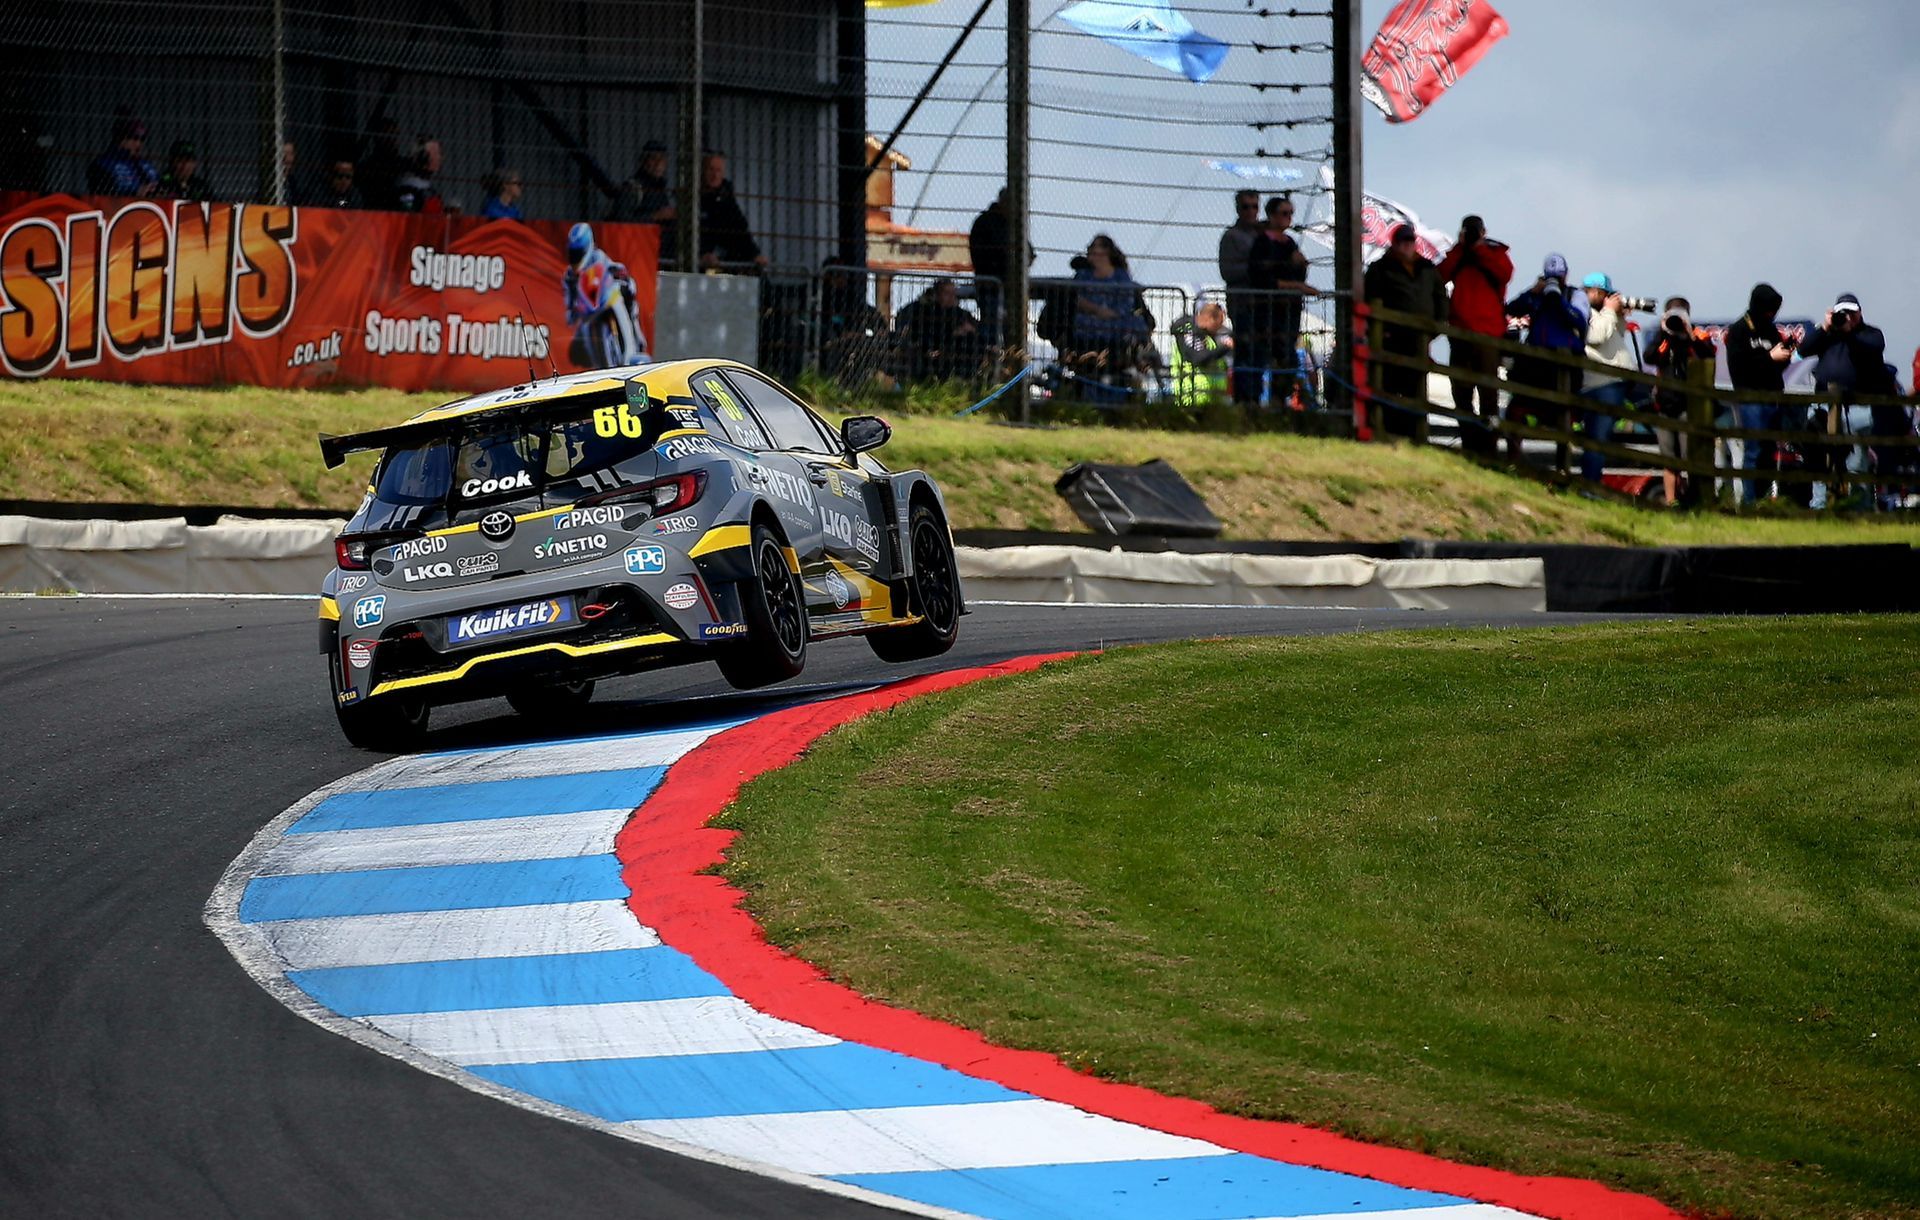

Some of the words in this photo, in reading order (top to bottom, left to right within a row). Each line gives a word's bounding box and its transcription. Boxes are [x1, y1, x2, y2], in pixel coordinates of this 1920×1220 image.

[411, 246, 505, 293] Signage
[0, 200, 298, 377] SIGNS
[365, 310, 441, 356] Sports
[446, 314, 550, 361] Trophies
[288, 331, 342, 367] .co.uk
[593, 404, 642, 439] 66
[672, 436, 721, 456] PAGID
[735, 424, 766, 447] Cook
[461, 470, 533, 497] Cook
[571, 506, 624, 527] PAGID
[661, 516, 698, 531] TRIO
[820, 505, 852, 546] LKQ
[402, 536, 447, 559] PAGID
[533, 534, 608, 559] SYNETIQ
[628, 549, 662, 570] PPG
[341, 576, 367, 591] TRIO
[404, 562, 455, 582] LKQ
[356, 600, 383, 622] PPG
